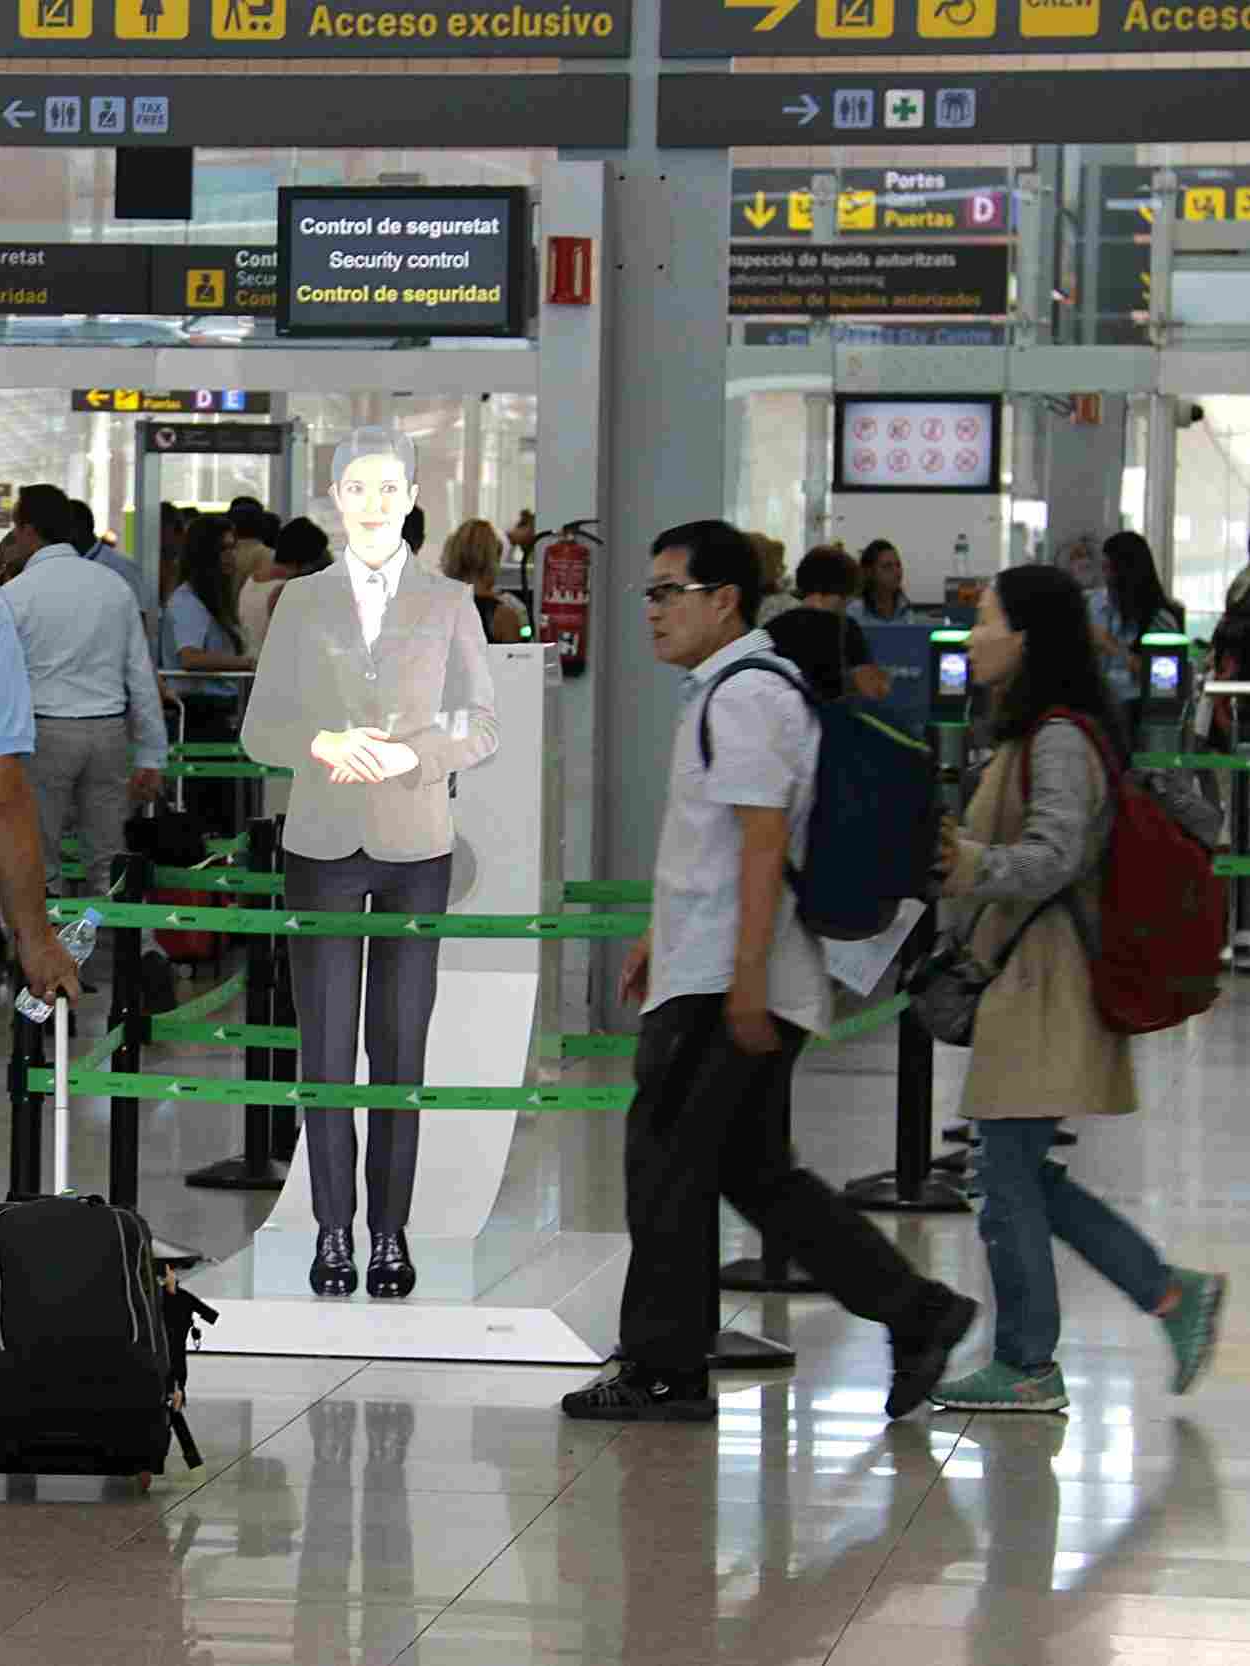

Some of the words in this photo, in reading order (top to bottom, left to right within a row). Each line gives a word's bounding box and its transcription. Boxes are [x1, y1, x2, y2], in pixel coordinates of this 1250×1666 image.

[310, 5, 438, 37] Acceso
[447, 5, 614, 37] exclusivo
[141, 102, 164, 112] TAX
[885, 171, 945, 190] Portes
[884, 209, 955, 228] Puertas
[972, 196, 995, 222] D
[300, 217, 372, 235] Control
[377, 217, 401, 235] de
[406, 217, 500, 239] seguretat
[329, 250, 403, 273] Security
[407, 250, 470, 269] control
[730, 252, 794, 269] nspecció
[296, 284, 369, 303] Control
[374, 284, 399, 302] de
[403, 285, 501, 307] seguridad
[195, 389, 213, 408] D
[224, 387, 240, 408] E
